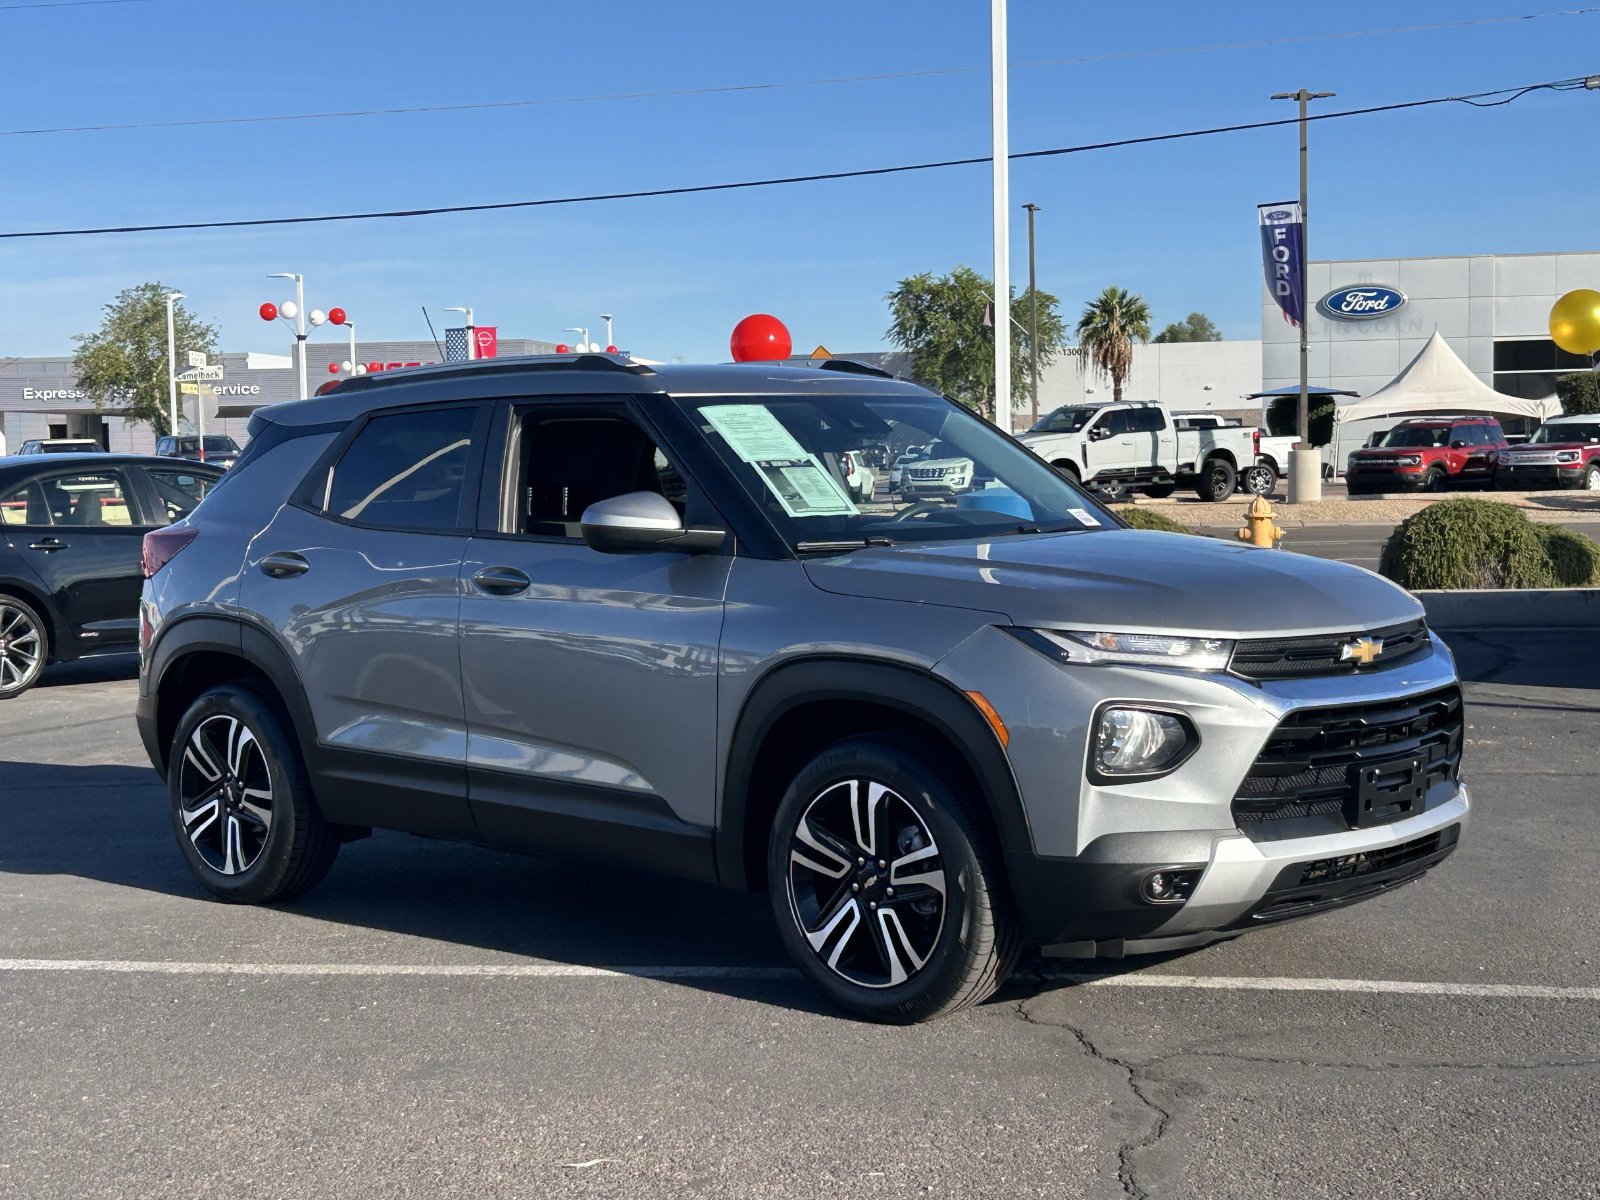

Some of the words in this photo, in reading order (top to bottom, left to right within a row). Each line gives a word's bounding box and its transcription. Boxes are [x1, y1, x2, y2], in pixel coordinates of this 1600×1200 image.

[1273, 228, 1291, 296] FORD
[1341, 291, 1390, 311] Ford
[177, 371, 220, 380] Camelback
[23, 387, 84, 401] Express
[208, 383, 260, 395] ervice
